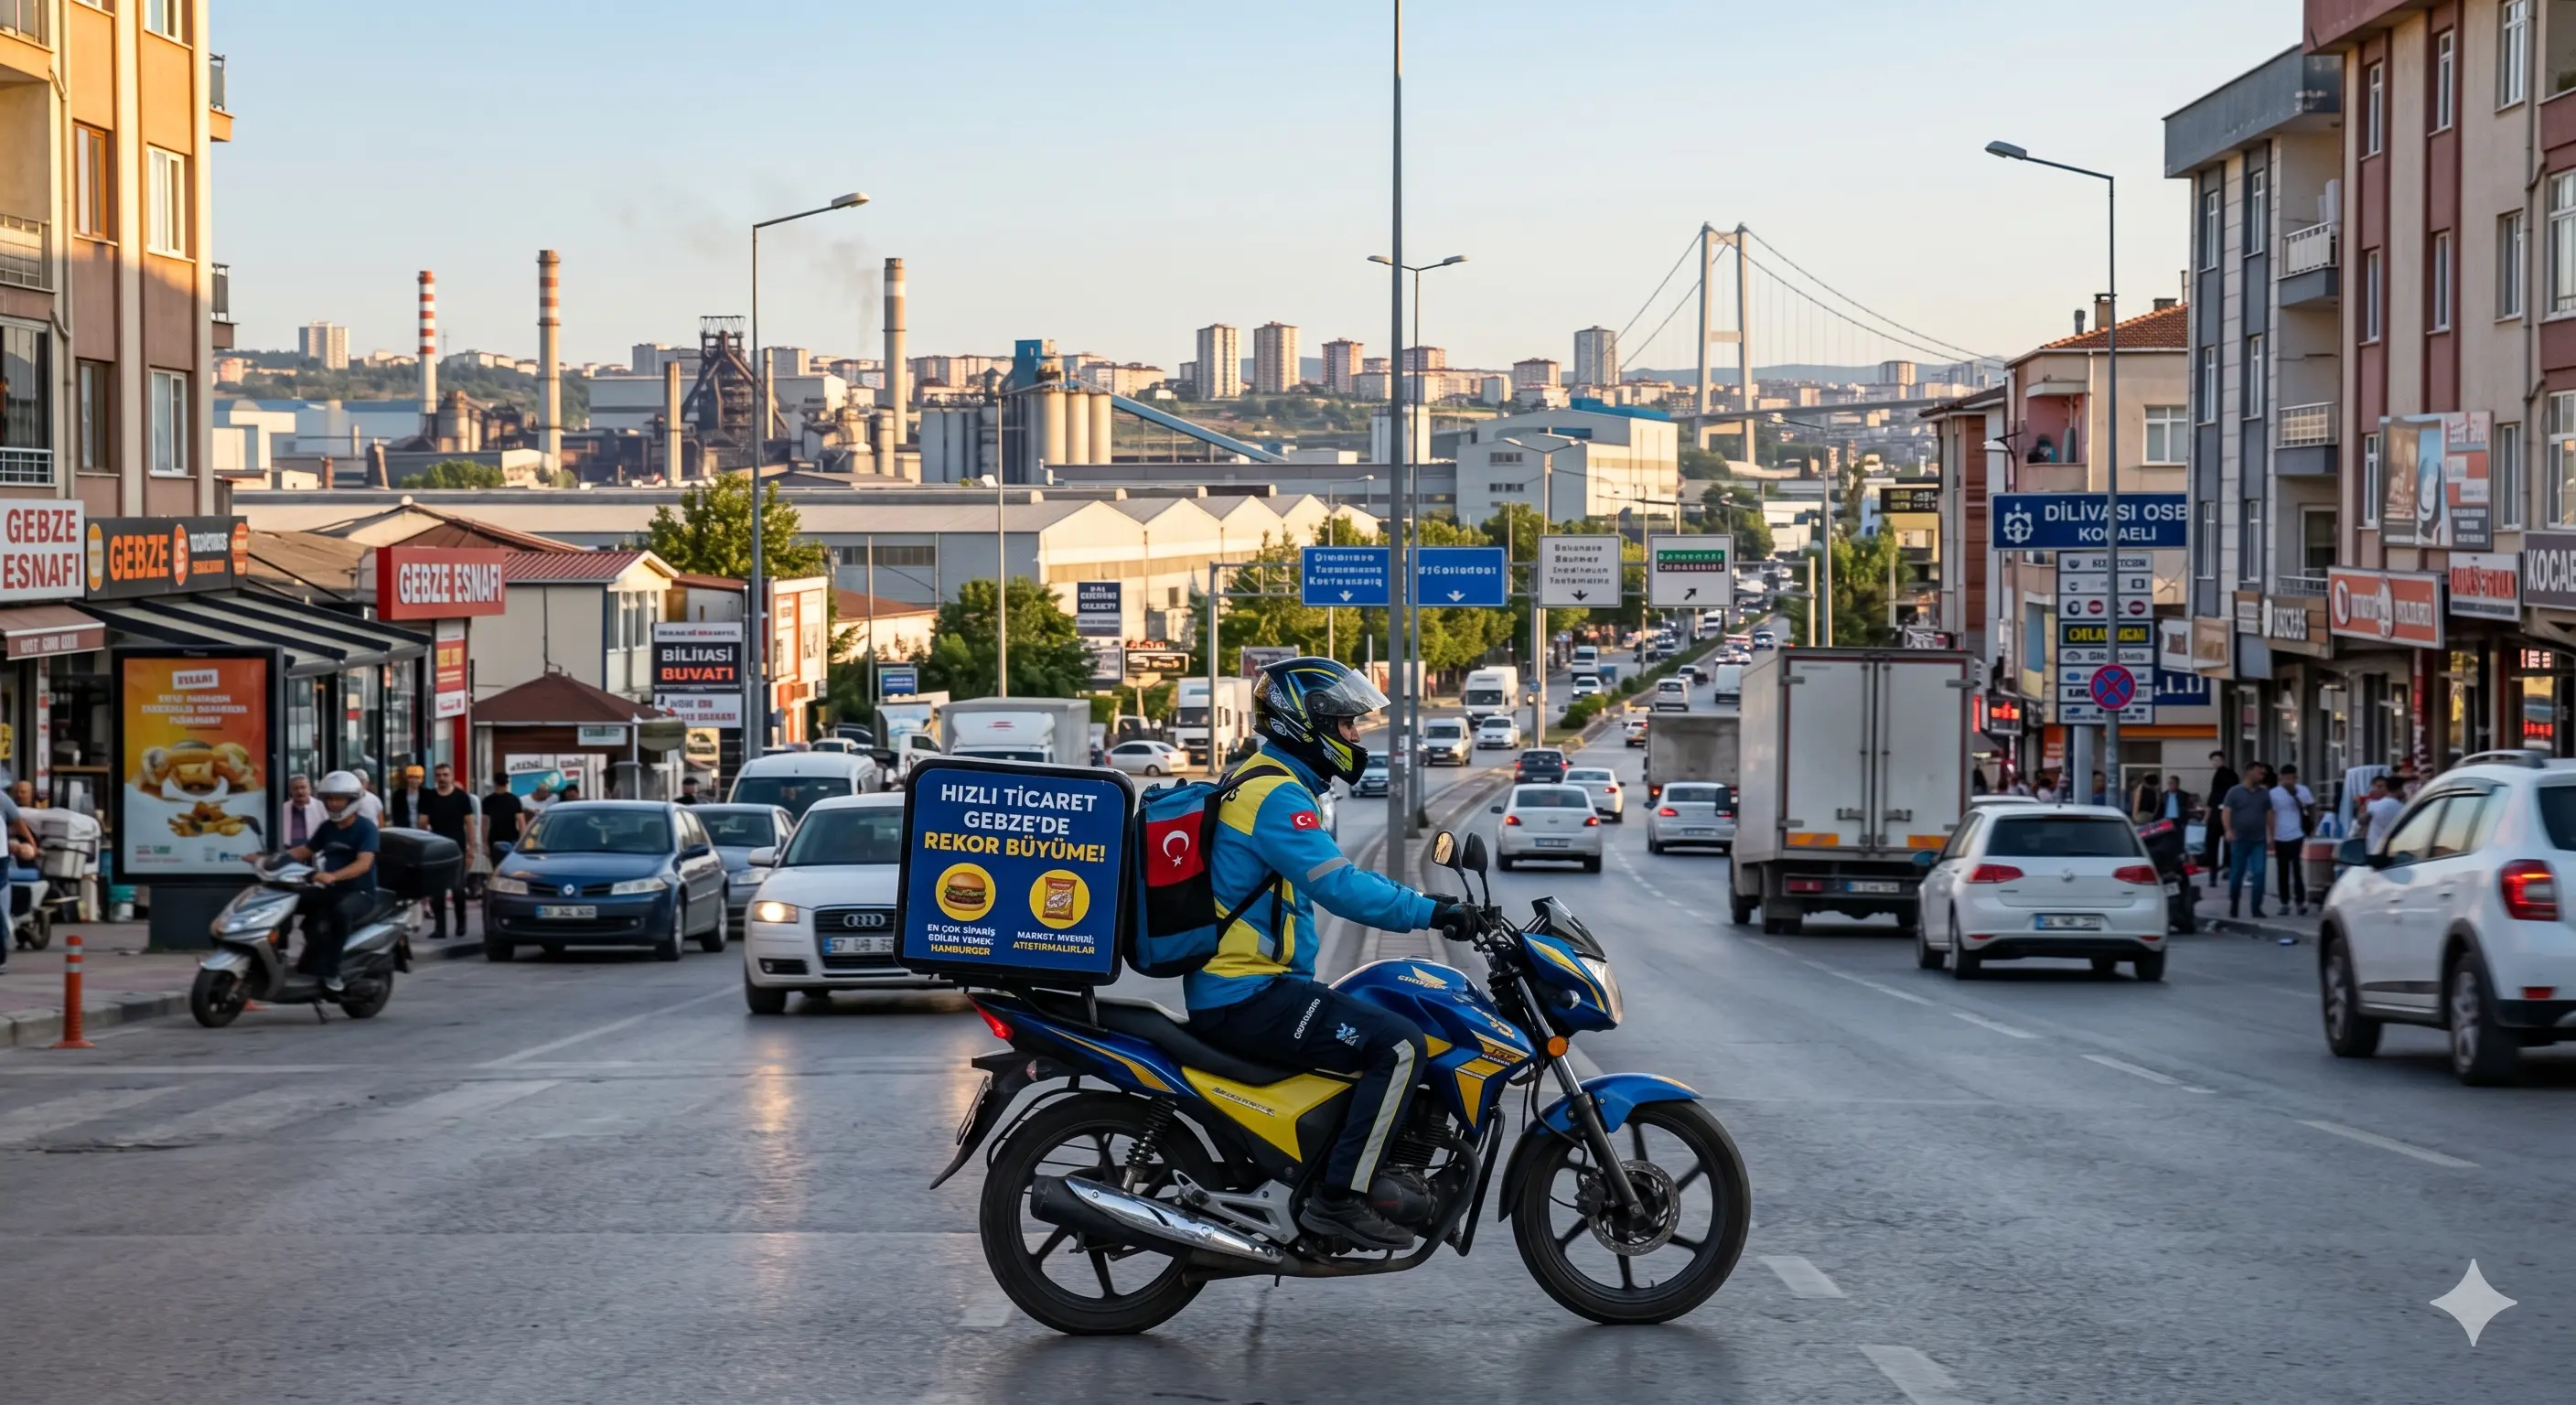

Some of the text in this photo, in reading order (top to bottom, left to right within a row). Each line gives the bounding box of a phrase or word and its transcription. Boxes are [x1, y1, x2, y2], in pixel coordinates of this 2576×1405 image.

[6, 509, 77, 543] GEBZE
[2078, 526, 2157, 542] KOAELİ
[3, 553, 80, 589] ESNAFI
[109, 534, 169, 581] GEBZE
[399, 563, 502, 604] GEBZE ESNAFI
[940, 784, 1098, 812] HIZLI TİCARET
[963, 810, 1070, 835] GEBZE'DE
[924, 831, 1106, 863] REKOR BÜYÜME!
[927, 923, 996, 937] EN ÇOK SİPARİŞ
[930, 943, 991, 956] HAMBURGER
